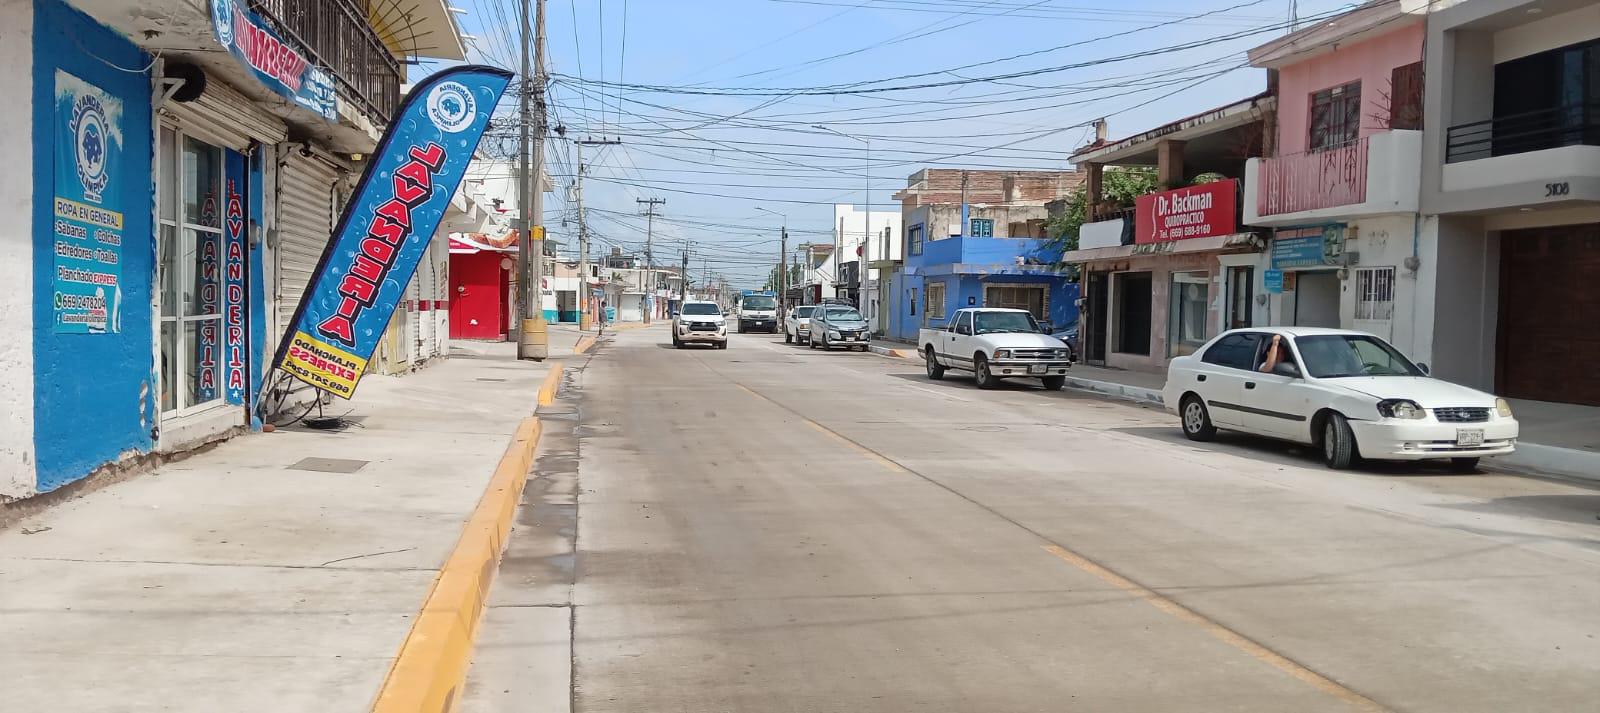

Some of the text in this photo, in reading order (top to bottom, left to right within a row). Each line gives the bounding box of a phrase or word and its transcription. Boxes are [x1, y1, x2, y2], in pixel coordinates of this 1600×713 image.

[70, 94, 110, 135] LAVANDERIA
[1545, 182, 1570, 197] 5108
[57, 201, 120, 228] ROPA EN GENERAL
[1158, 190, 1212, 216] Dr. Backman
[58, 266, 117, 286] Planchado EXPRESS
[227, 179, 244, 390] LAVANDERIA
